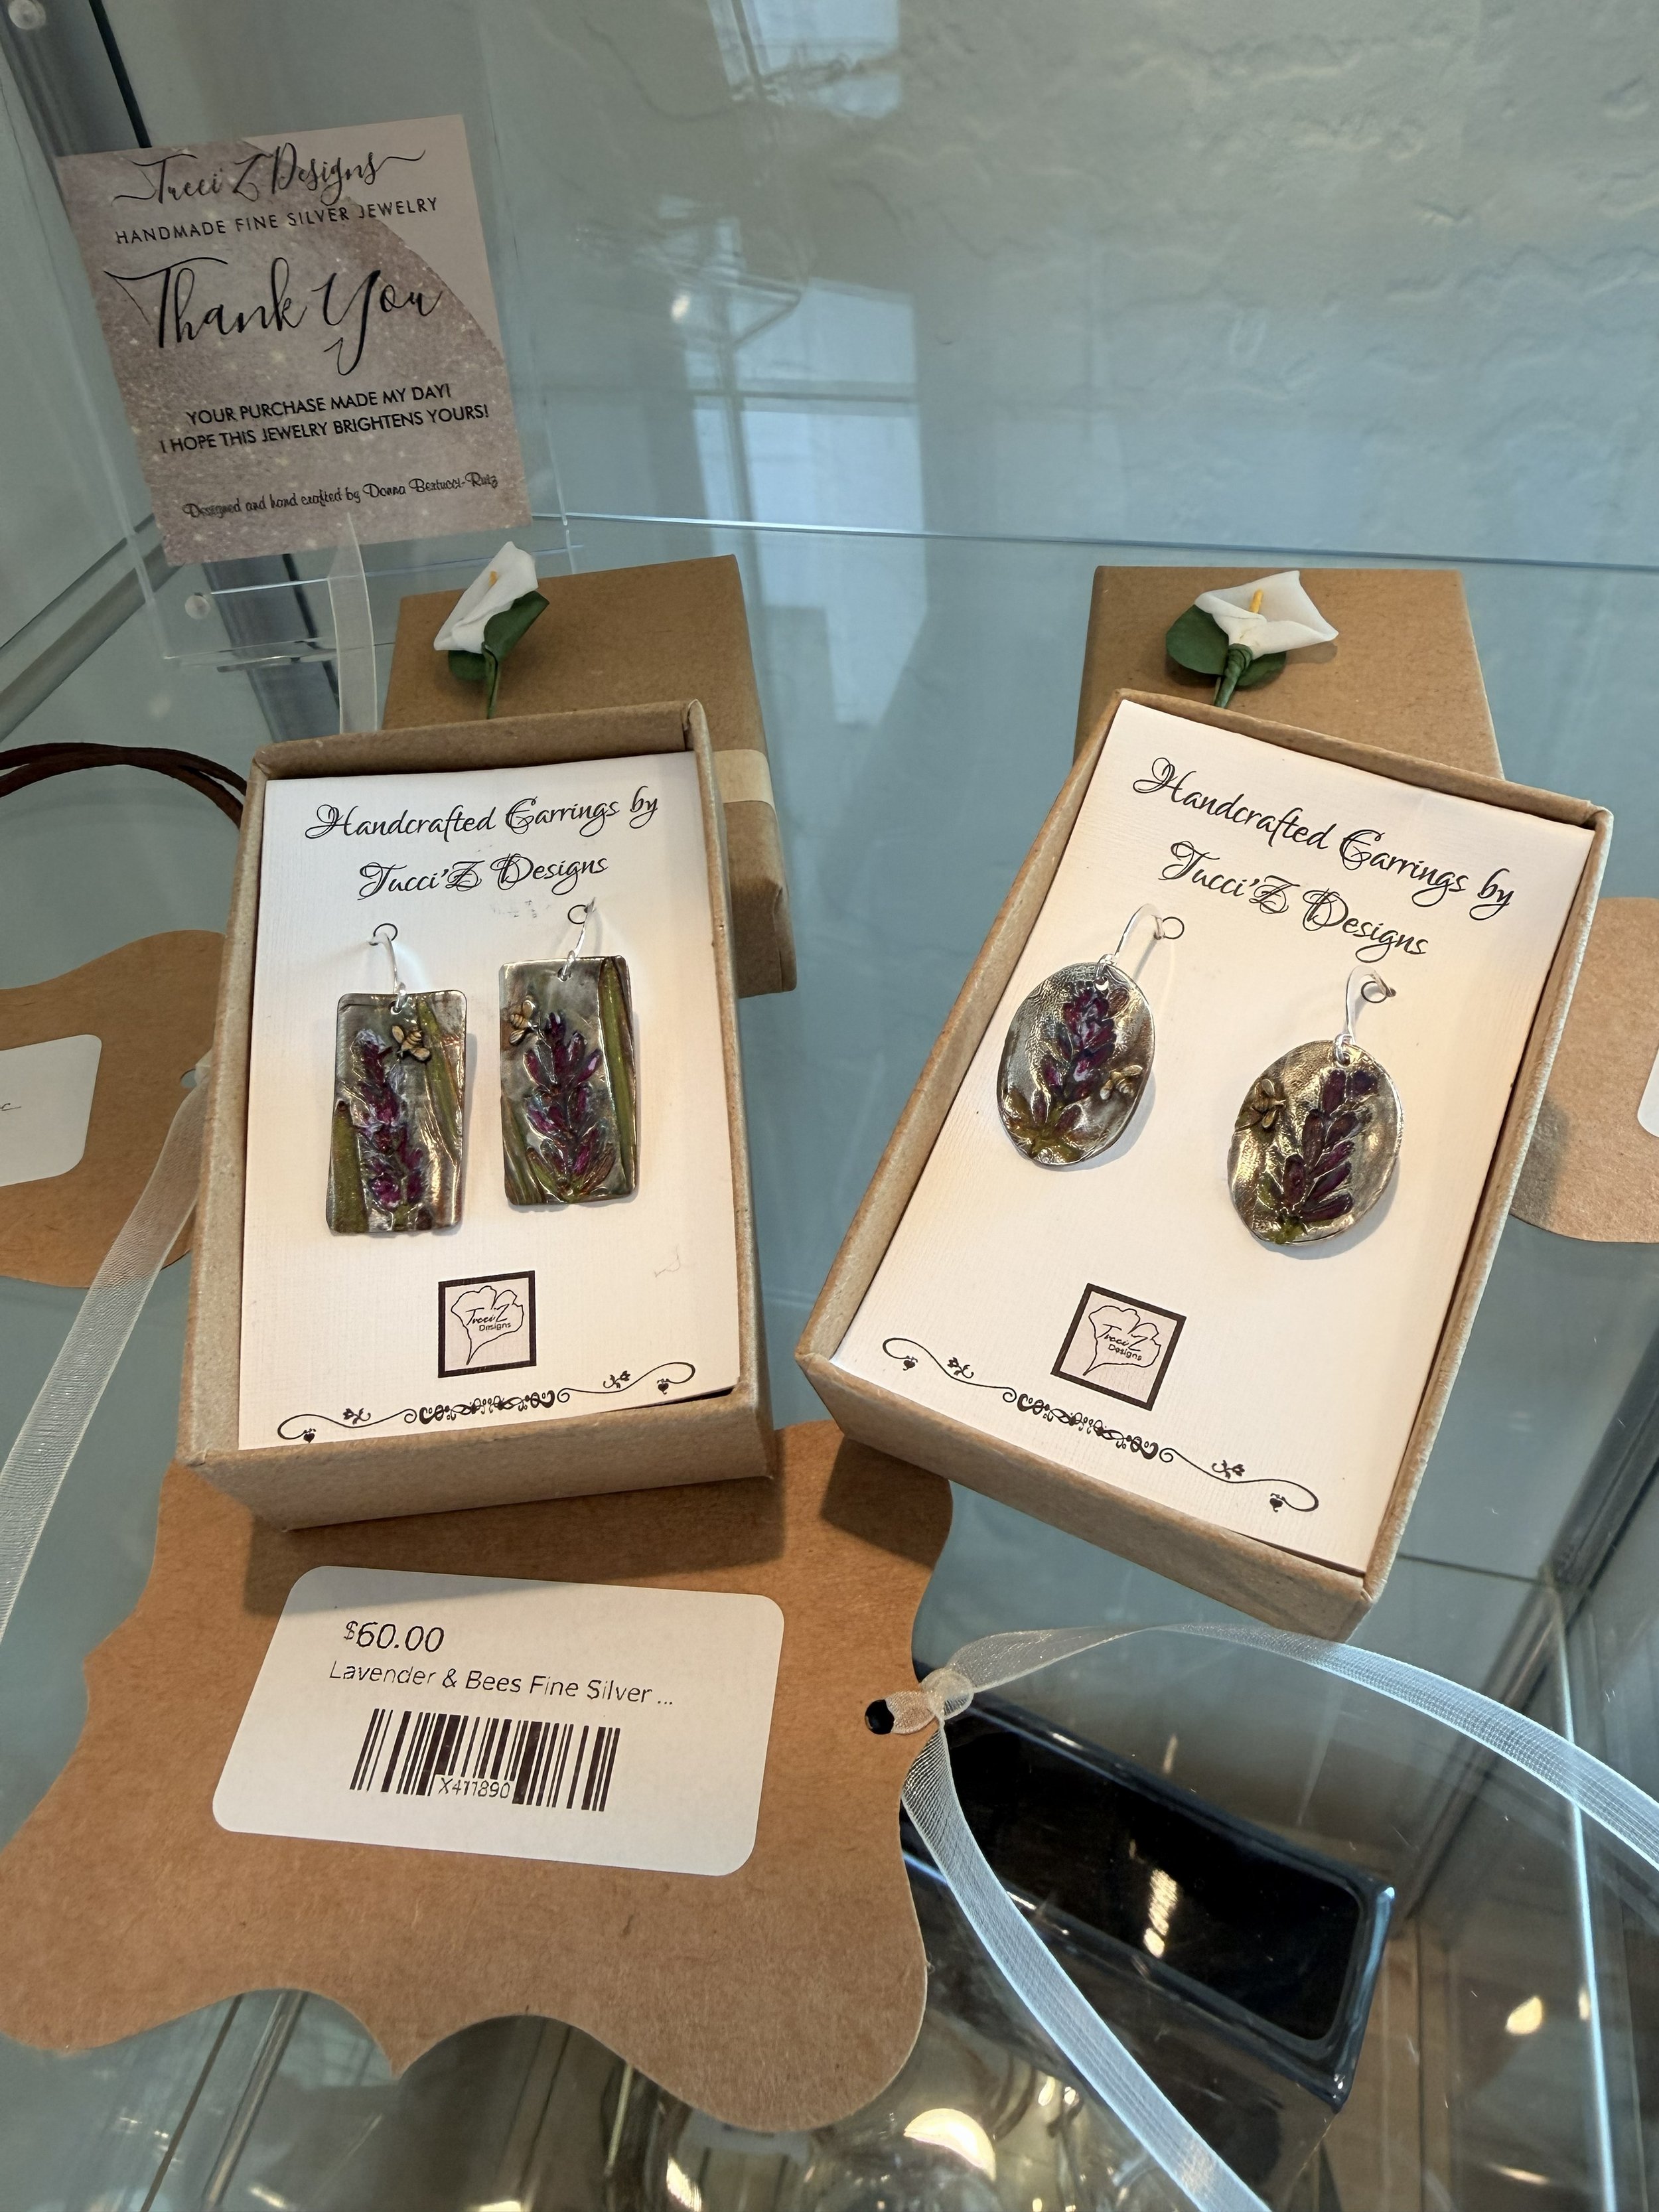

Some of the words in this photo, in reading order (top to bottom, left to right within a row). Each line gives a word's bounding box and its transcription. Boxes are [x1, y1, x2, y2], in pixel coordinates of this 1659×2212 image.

[271, 142, 425, 206] Designs
[115, 220, 226, 244] HANDMADE
[235, 214, 278, 232] FINE
[288, 206, 350, 226] SILVER
[358, 196, 437, 218] JEWELRY
[104, 256, 307, 348] Thank
[311, 269, 443, 376] You
[186, 407, 236, 425] YOUR
[240, 398, 326, 419] PURCHASE
[330, 392, 378, 409] MADE
[383, 388, 406, 404] MY
[411, 383, 452, 401] DAY!
[159, 439, 167, 453] I
[169, 433, 217, 452] HOPE
[219, 429, 257, 446] THIS
[262, 421, 328, 443] JEWELRY
[332, 411, 423, 435] BRIGHTENS
[426, 404, 490, 424] YOURS!
[246, 495, 267, 512] and
[269, 492, 299, 508] hand
[301, 487, 343, 506] crafted
[345, 486, 361, 503] by
[362, 483, 406, 498] Donna
[305, 804, 496, 842] Handcrafted
[504, 796, 620, 838] Earrings
[629, 785, 659, 830] by
[1132, 757, 1338, 850] Handcrafted
[1338, 828, 1469, 908] Earrings
[1469, 867, 1515, 921] by
[490, 853, 609, 895] Designs
[1302, 887, 1429, 964] Designs
[1108, 1344, 1142, 1361] Designs
[343, 1620, 445, 1653] $60.00
[329, 1660, 437, 1685] Lavender
[442, 1668, 457, 1688] &
[465, 1670, 522, 1692] Bees
[529, 1675, 579, 1697] Fine
[438, 1777, 510, 1799] X411890
